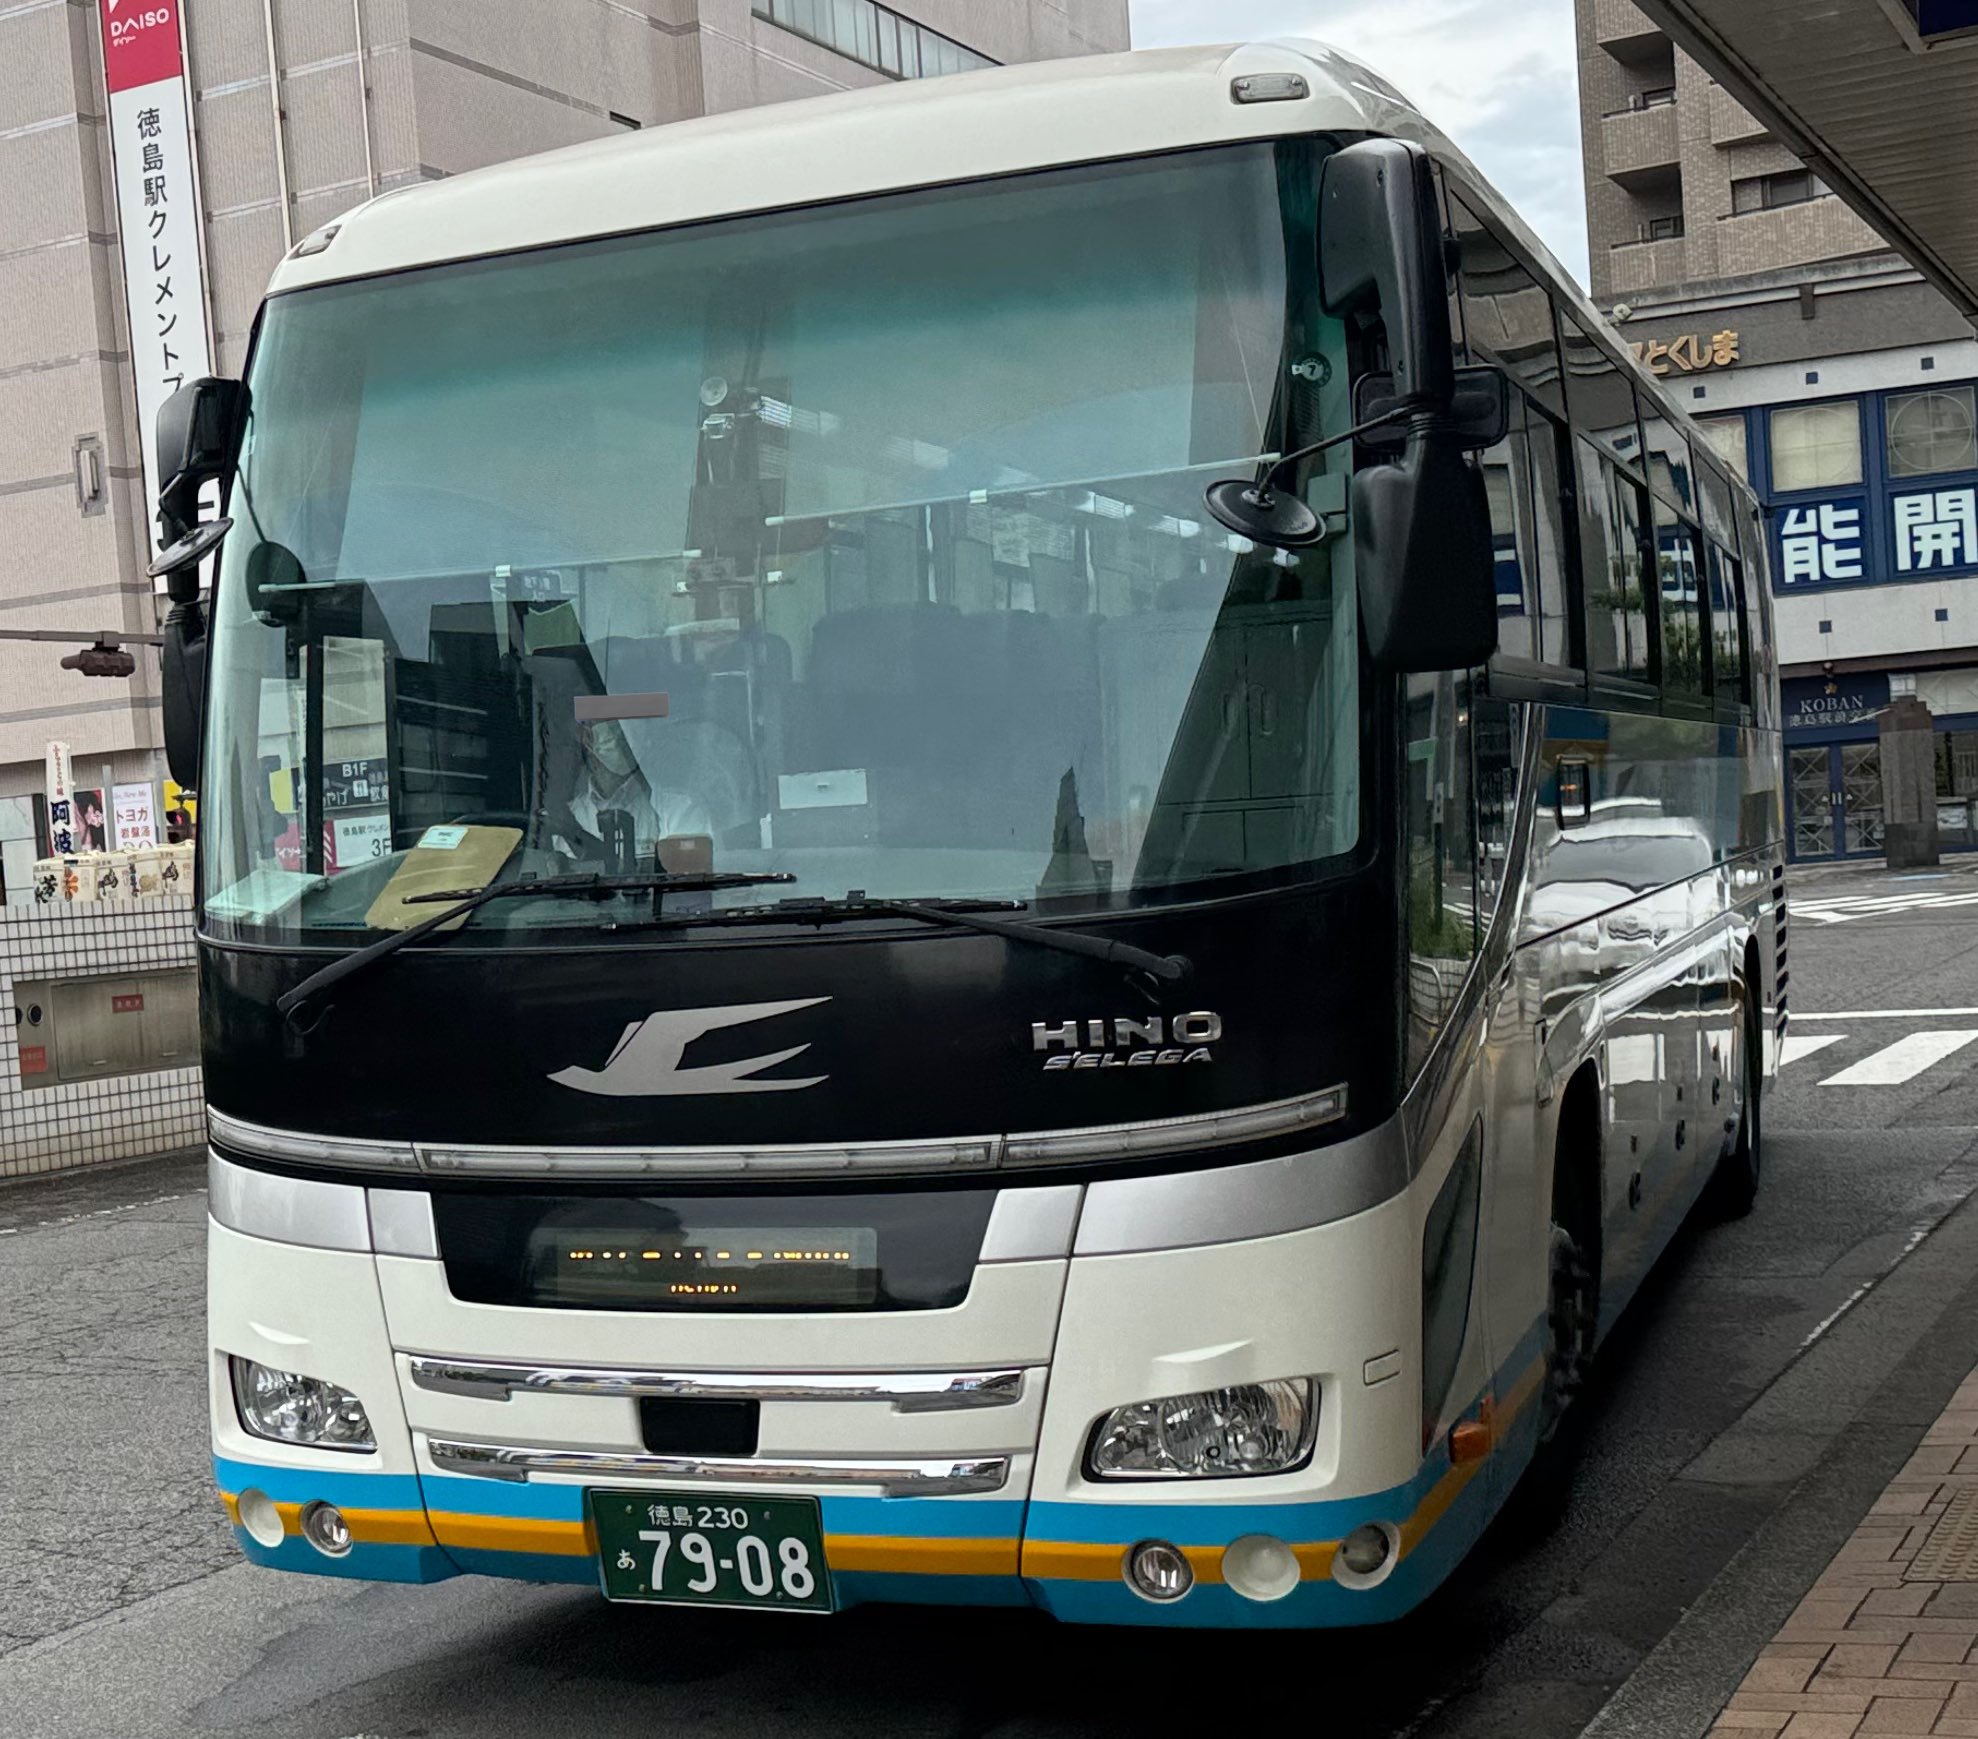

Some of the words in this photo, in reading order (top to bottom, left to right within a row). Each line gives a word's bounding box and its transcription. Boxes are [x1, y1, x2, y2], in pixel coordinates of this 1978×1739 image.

[110, 8, 169, 37] DAISO
[1800, 695, 1864, 713] KOBAN
[342, 762, 368, 777] B1F
[371, 838, 391, 857] 3F
[1031, 1010, 1223, 1050] HINO
[648, 1504, 693, 1527] 徳島
[697, 1506, 749, 1529] 230
[616, 1549, 636, 1571] あ
[638, 1530, 815, 1599] 79-08
